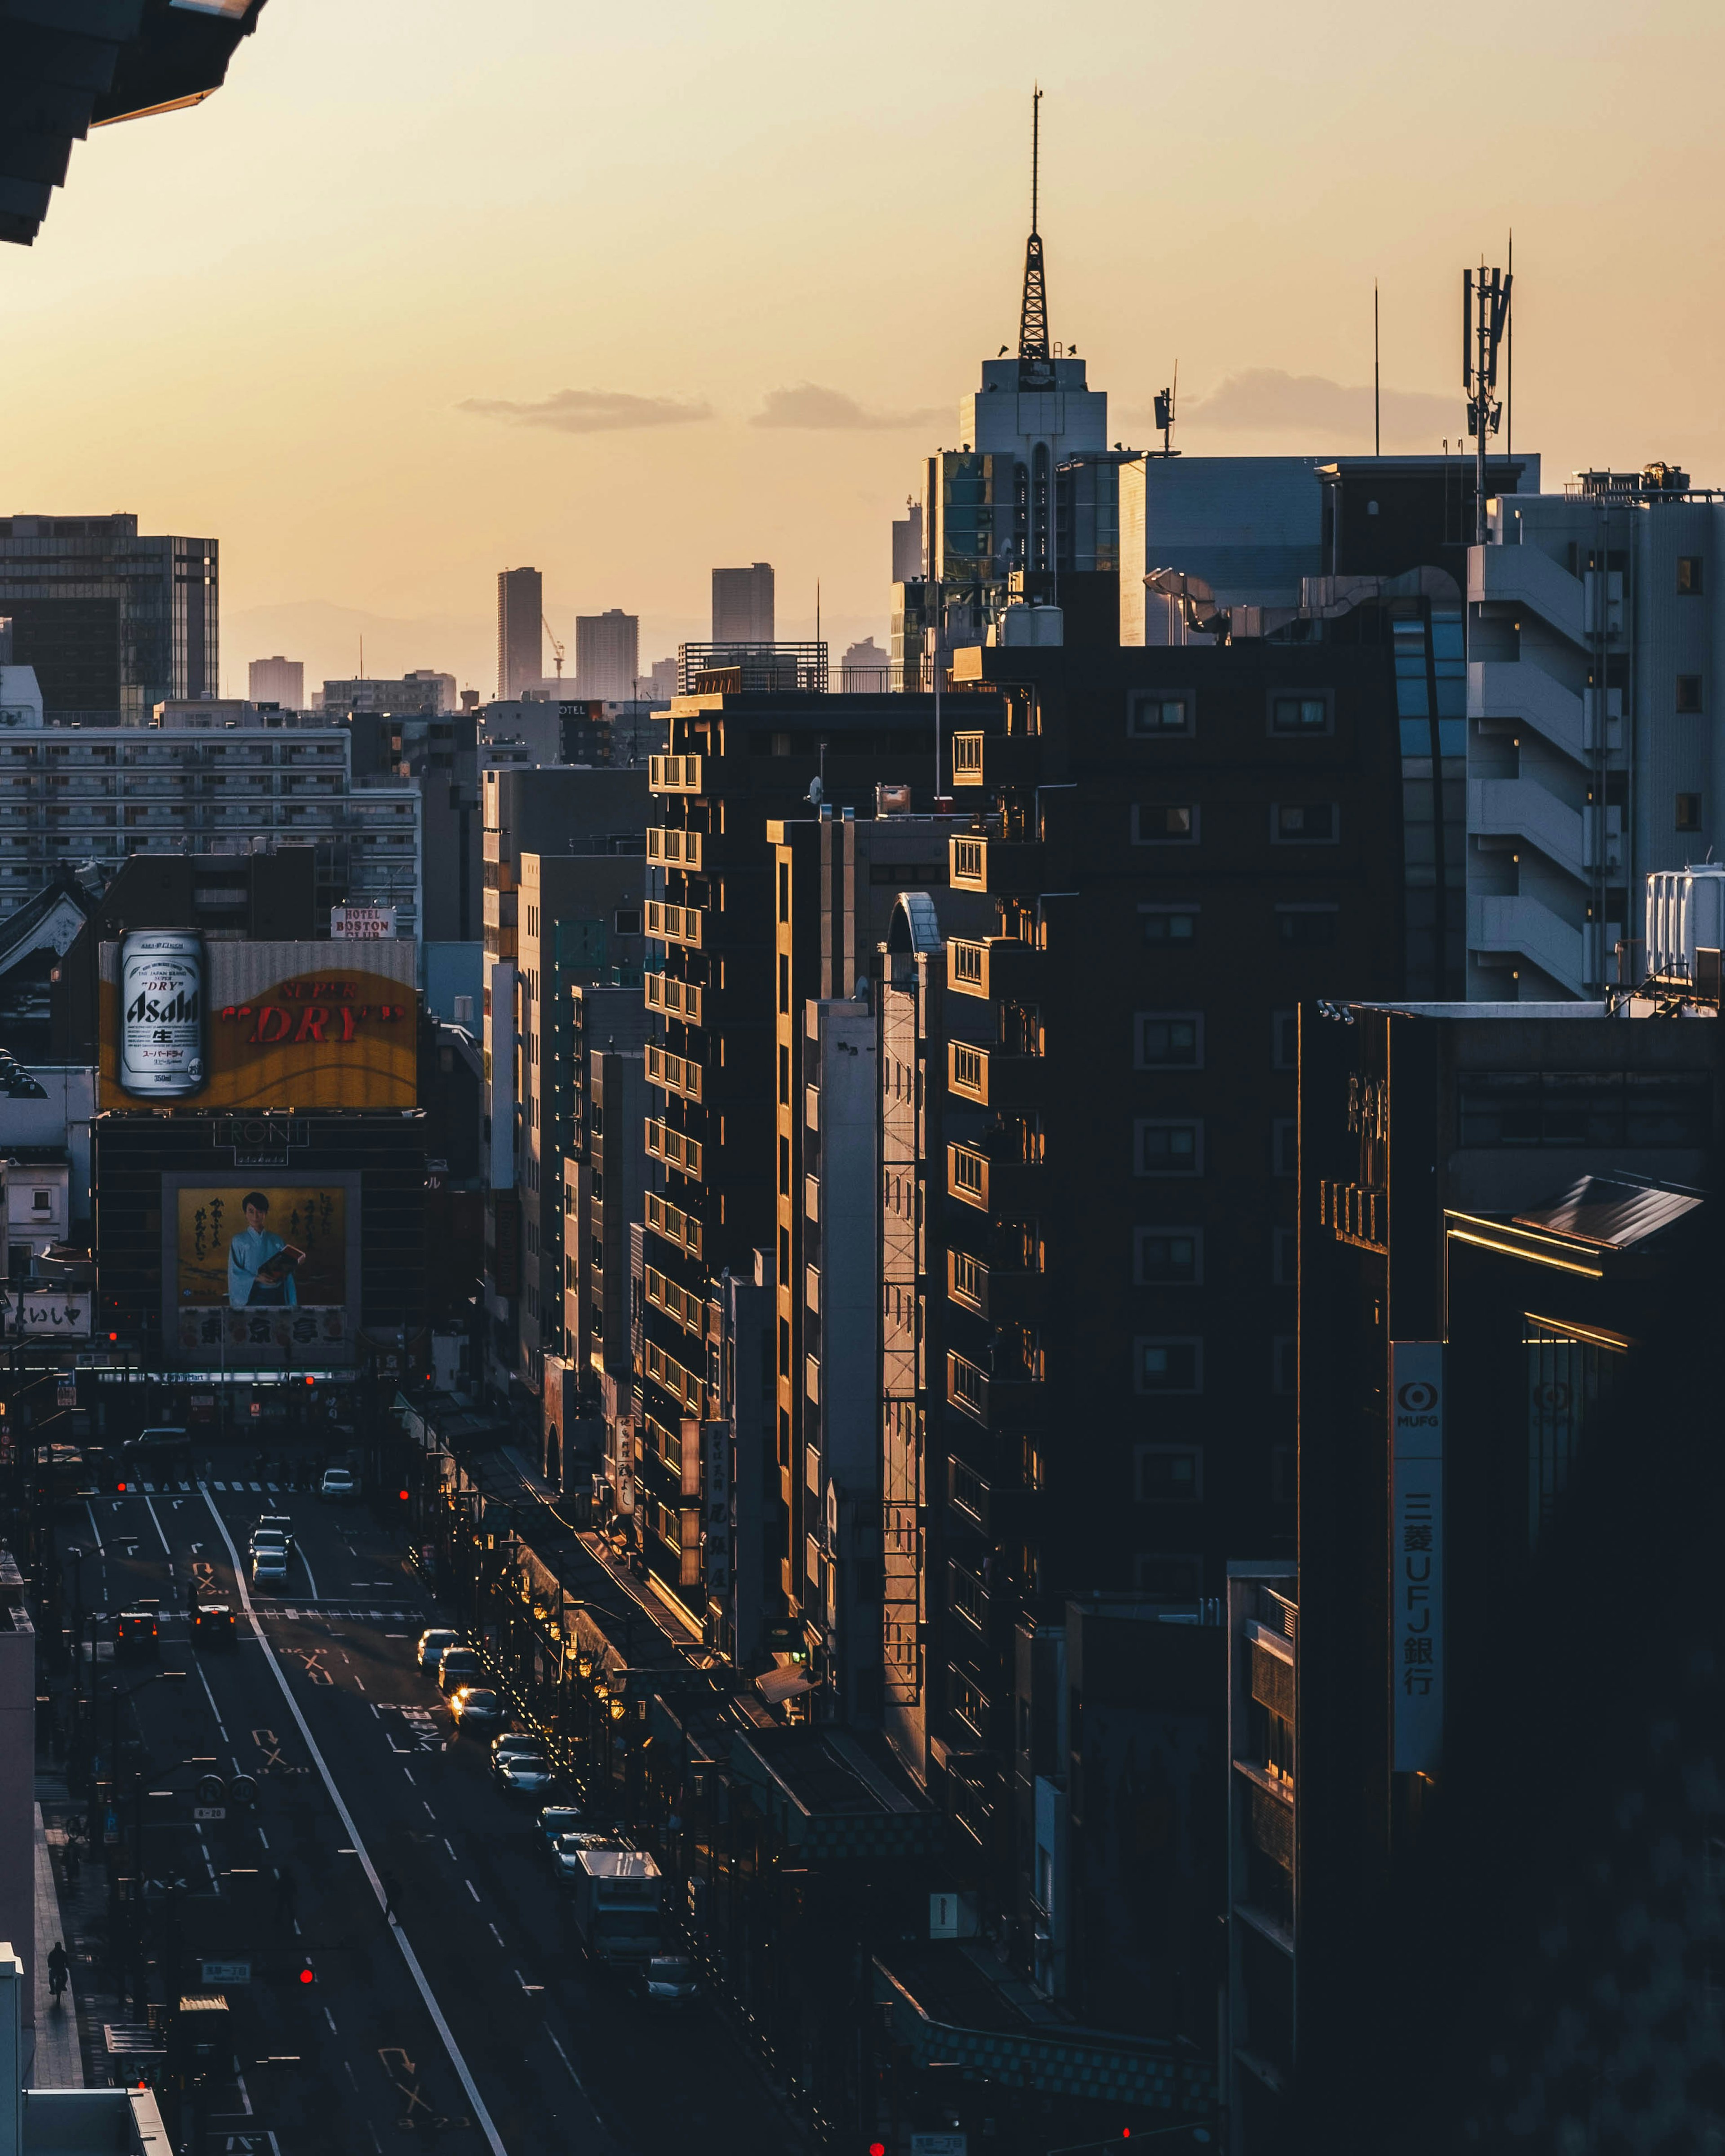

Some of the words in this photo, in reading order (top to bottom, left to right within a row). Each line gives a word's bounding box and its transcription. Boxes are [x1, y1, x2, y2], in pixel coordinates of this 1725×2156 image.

[346, 910, 380, 919] HOTEL
[336, 921, 388, 931] BOSTON
[127, 990, 198, 1023] Asahi
[153, 1029, 173, 1043] 生
[217, 1120, 304, 1144] FRONT
[1397, 1415, 1439, 1427] MUFG
[1404, 1493, 1433, 1696] 三菱UFJ銀行
